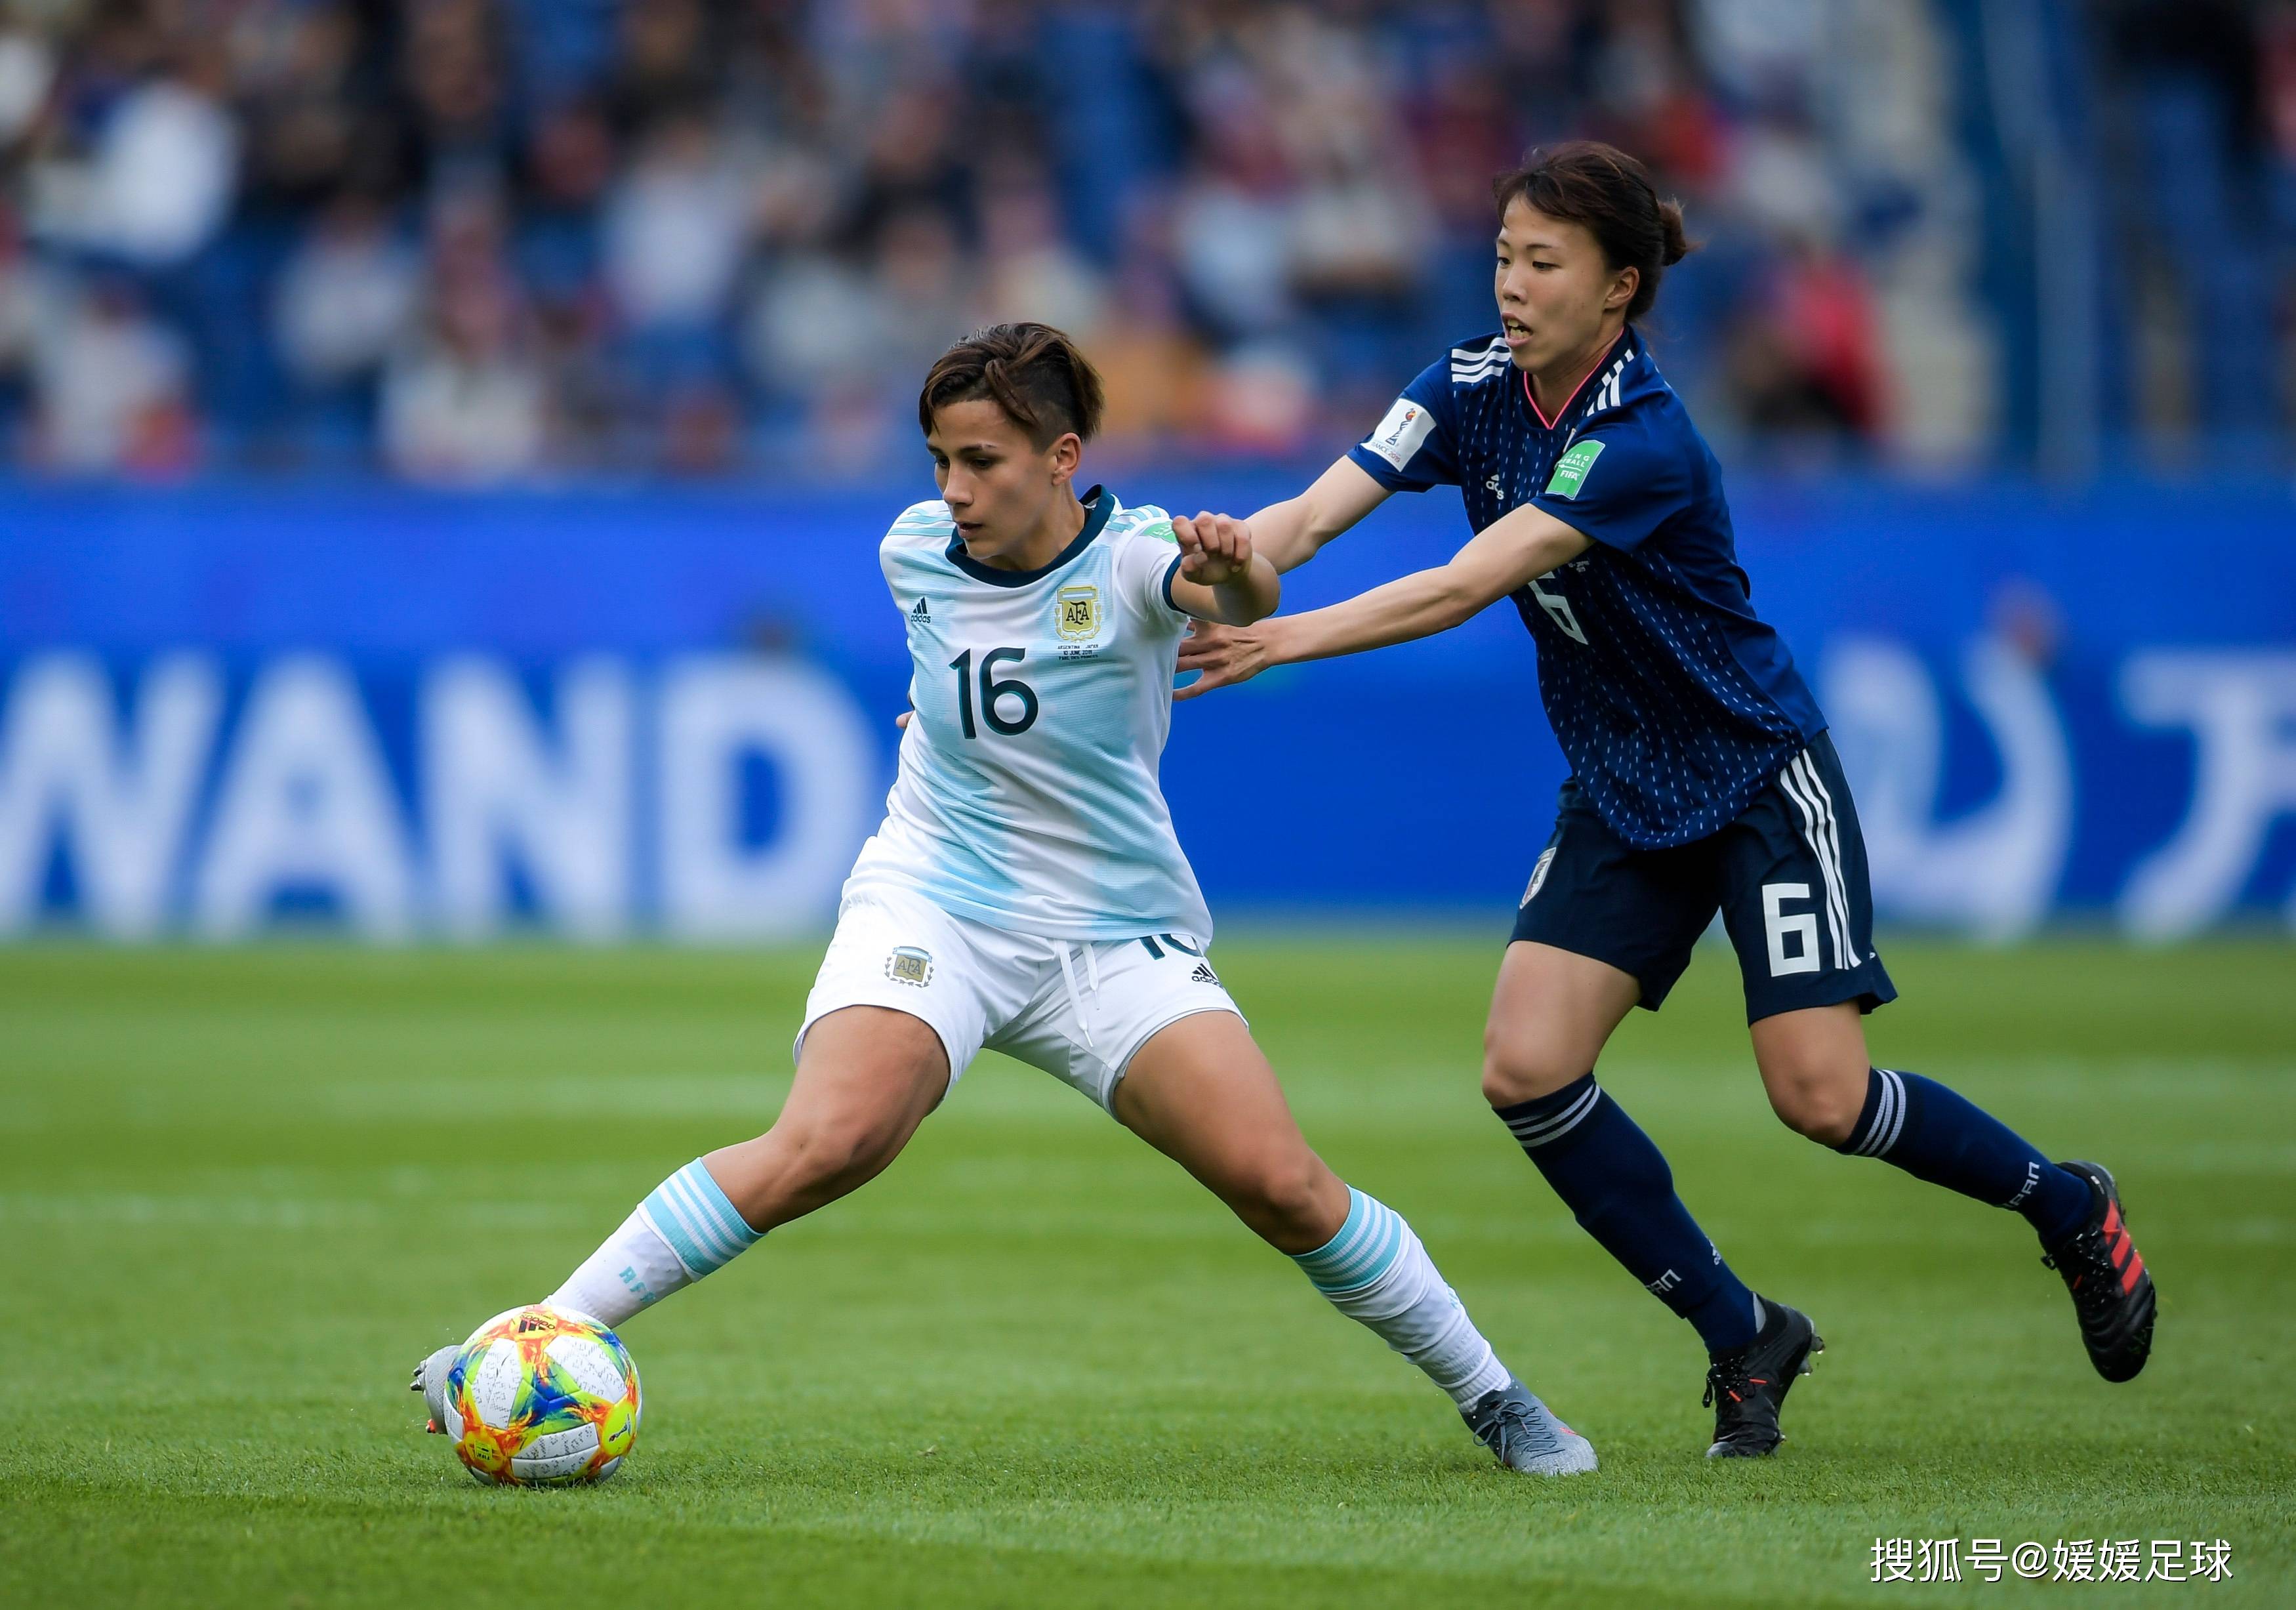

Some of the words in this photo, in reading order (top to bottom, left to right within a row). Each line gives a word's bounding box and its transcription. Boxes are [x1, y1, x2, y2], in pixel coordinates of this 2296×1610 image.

[1560, 470, 1578, 481] FIFA
[1065, 601, 1090, 625] AFA
[949, 647, 1039, 740] 16
[1762, 883, 1821, 978] 6
[895, 956, 922, 976] AFA
